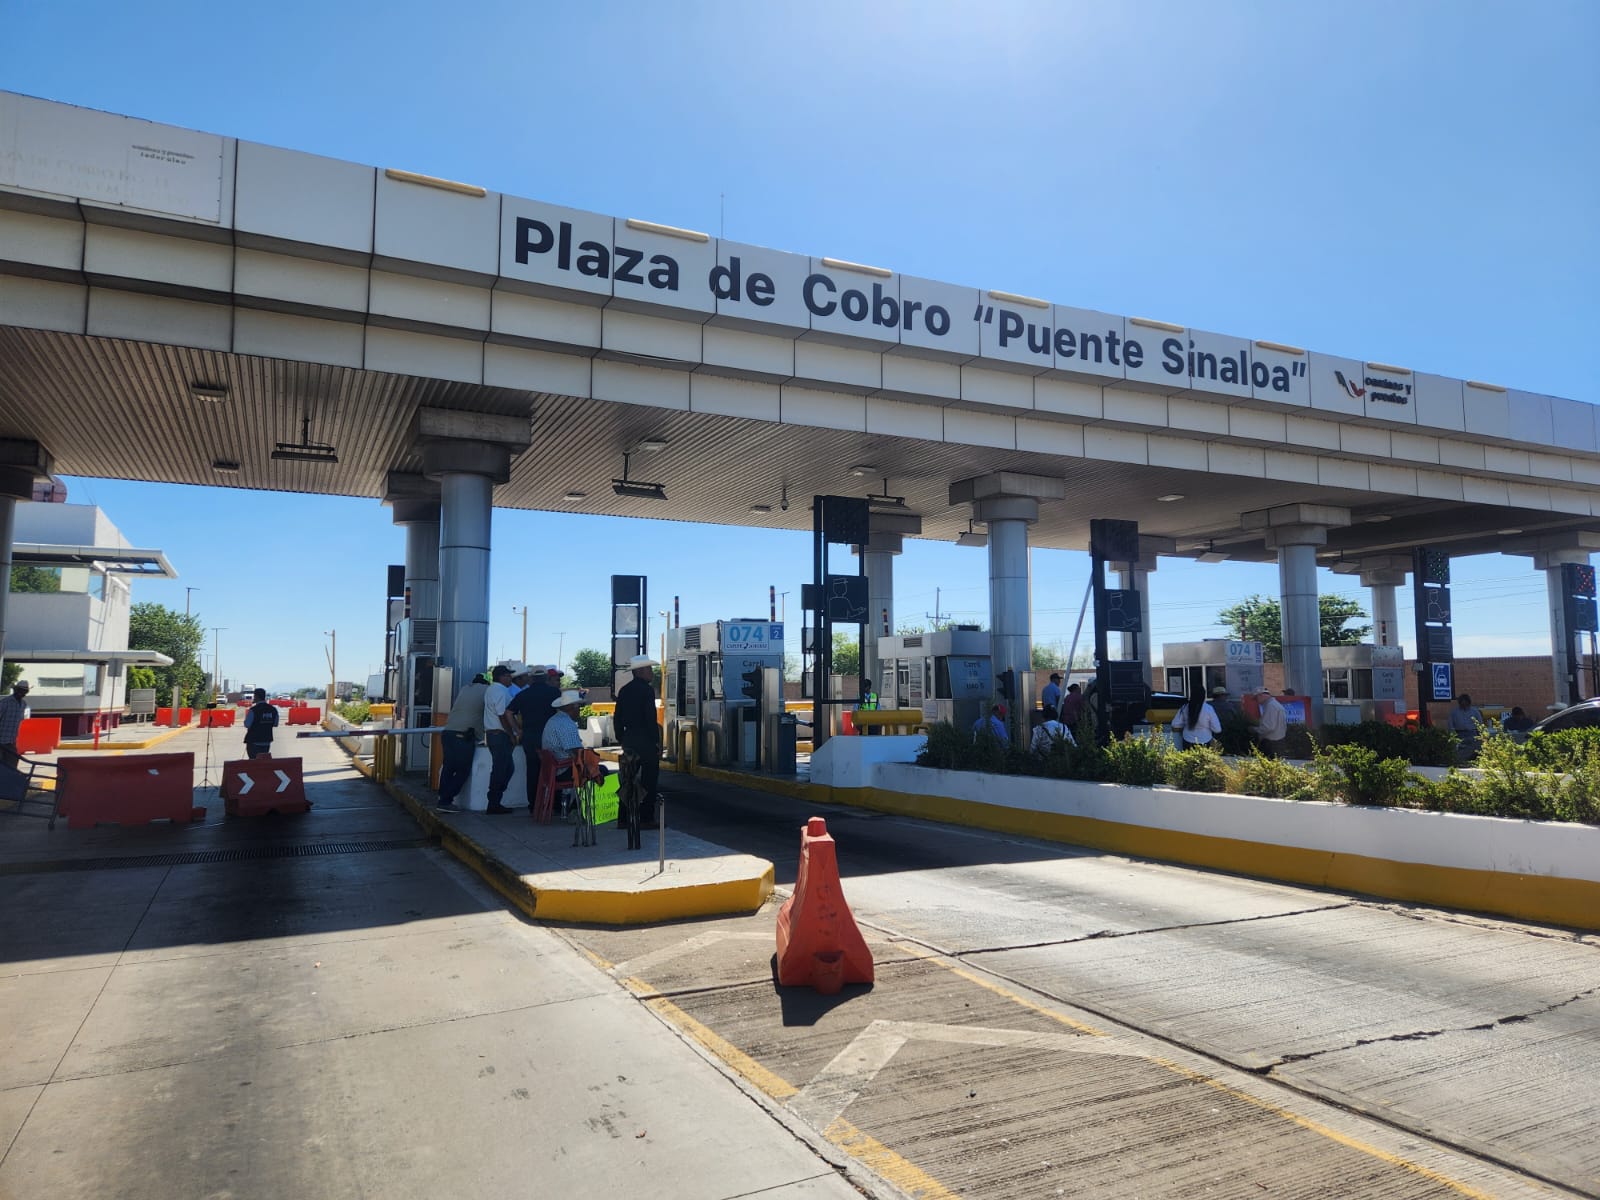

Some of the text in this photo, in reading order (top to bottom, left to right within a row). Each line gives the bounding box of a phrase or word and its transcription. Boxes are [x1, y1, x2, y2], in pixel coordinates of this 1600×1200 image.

[515, 216, 679, 291] Plaza
[708, 256, 776, 306] de
[802, 273, 951, 336] Cobro
[973, 304, 1144, 369] “Puente
[729, 626, 763, 642] 074
[773, 630, 780, 639] 2
[1230, 643, 1250, 656] 074
